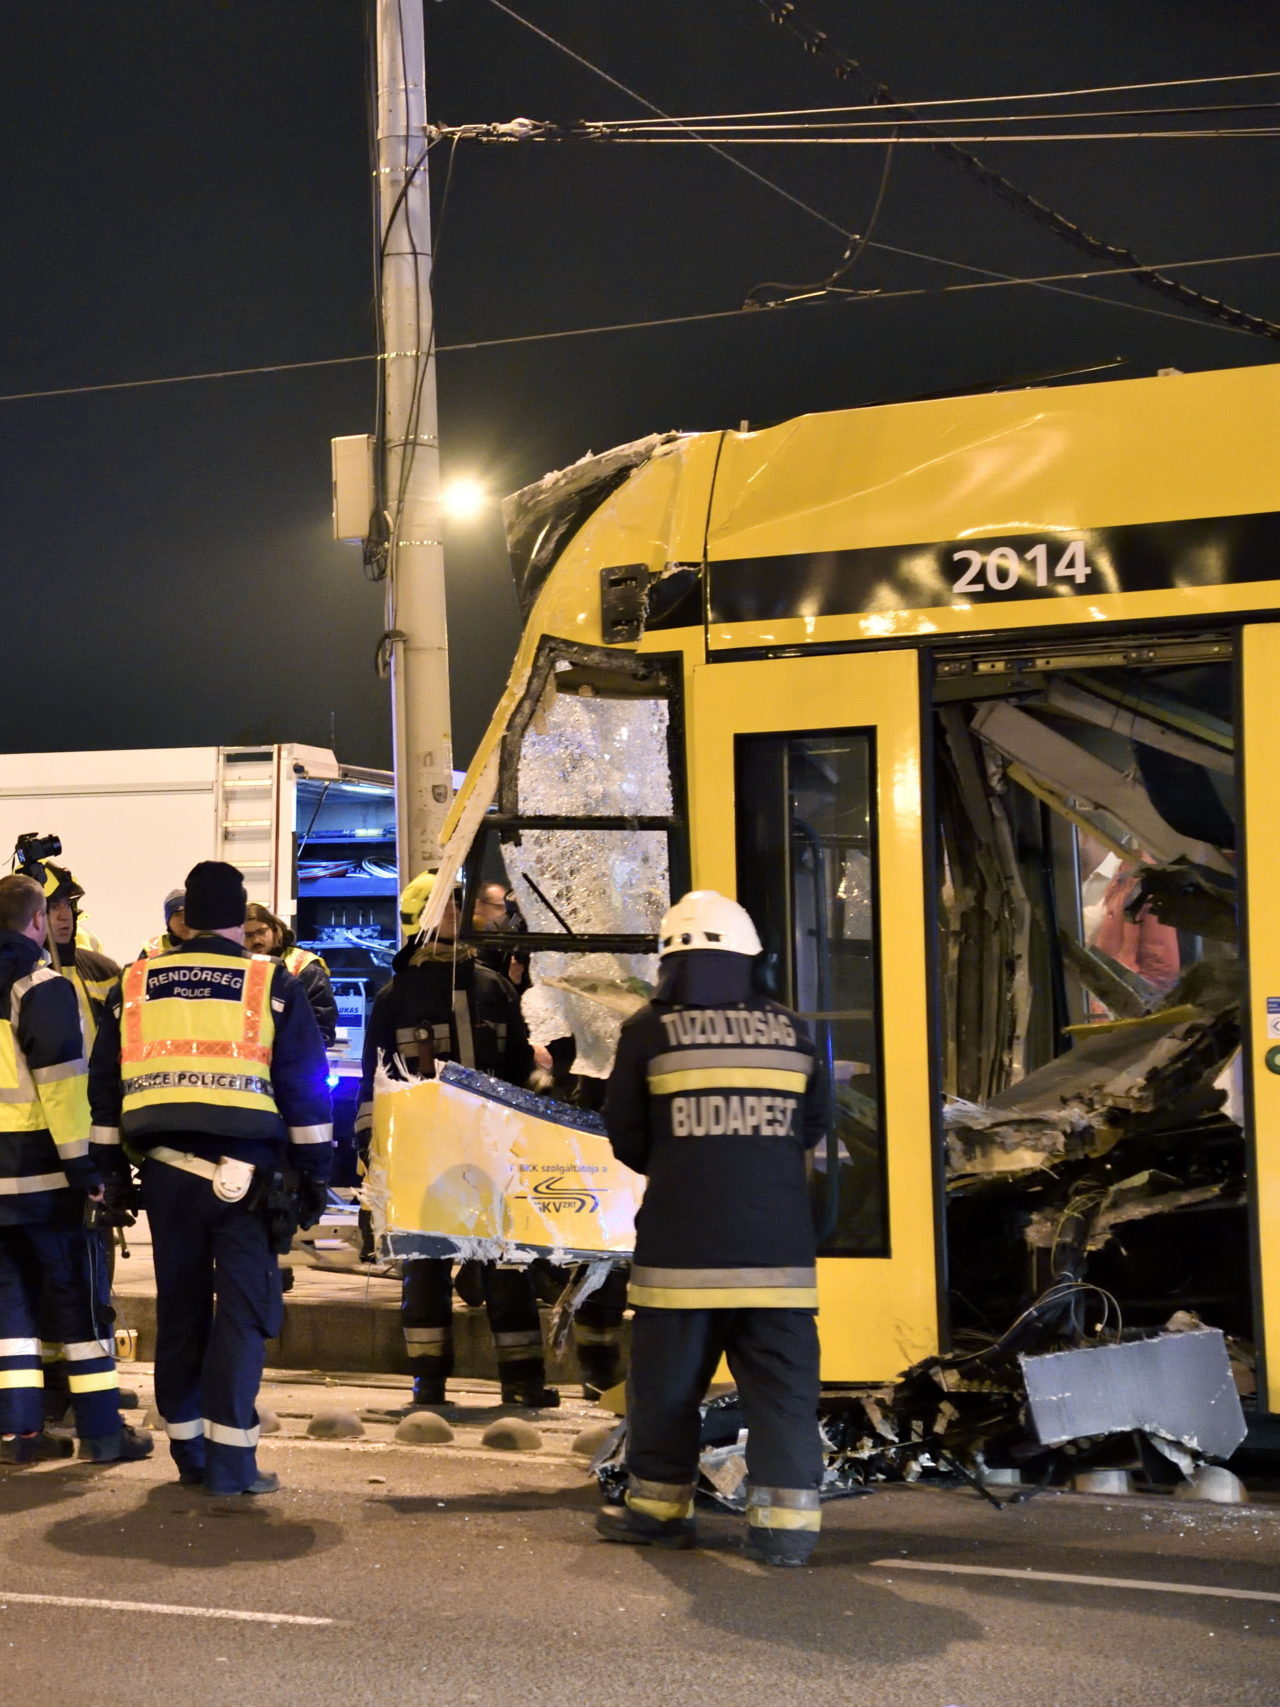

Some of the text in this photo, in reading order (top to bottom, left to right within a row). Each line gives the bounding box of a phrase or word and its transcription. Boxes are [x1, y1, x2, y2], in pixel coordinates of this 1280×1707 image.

[952, 541, 1092, 593] 2014
[148, 967, 242, 989] RENDŐRSÉG
[173, 986, 211, 997] POLICE
[177, 1073, 239, 1089] POLICE
[672, 1095, 797, 1137] BUDAPEST
